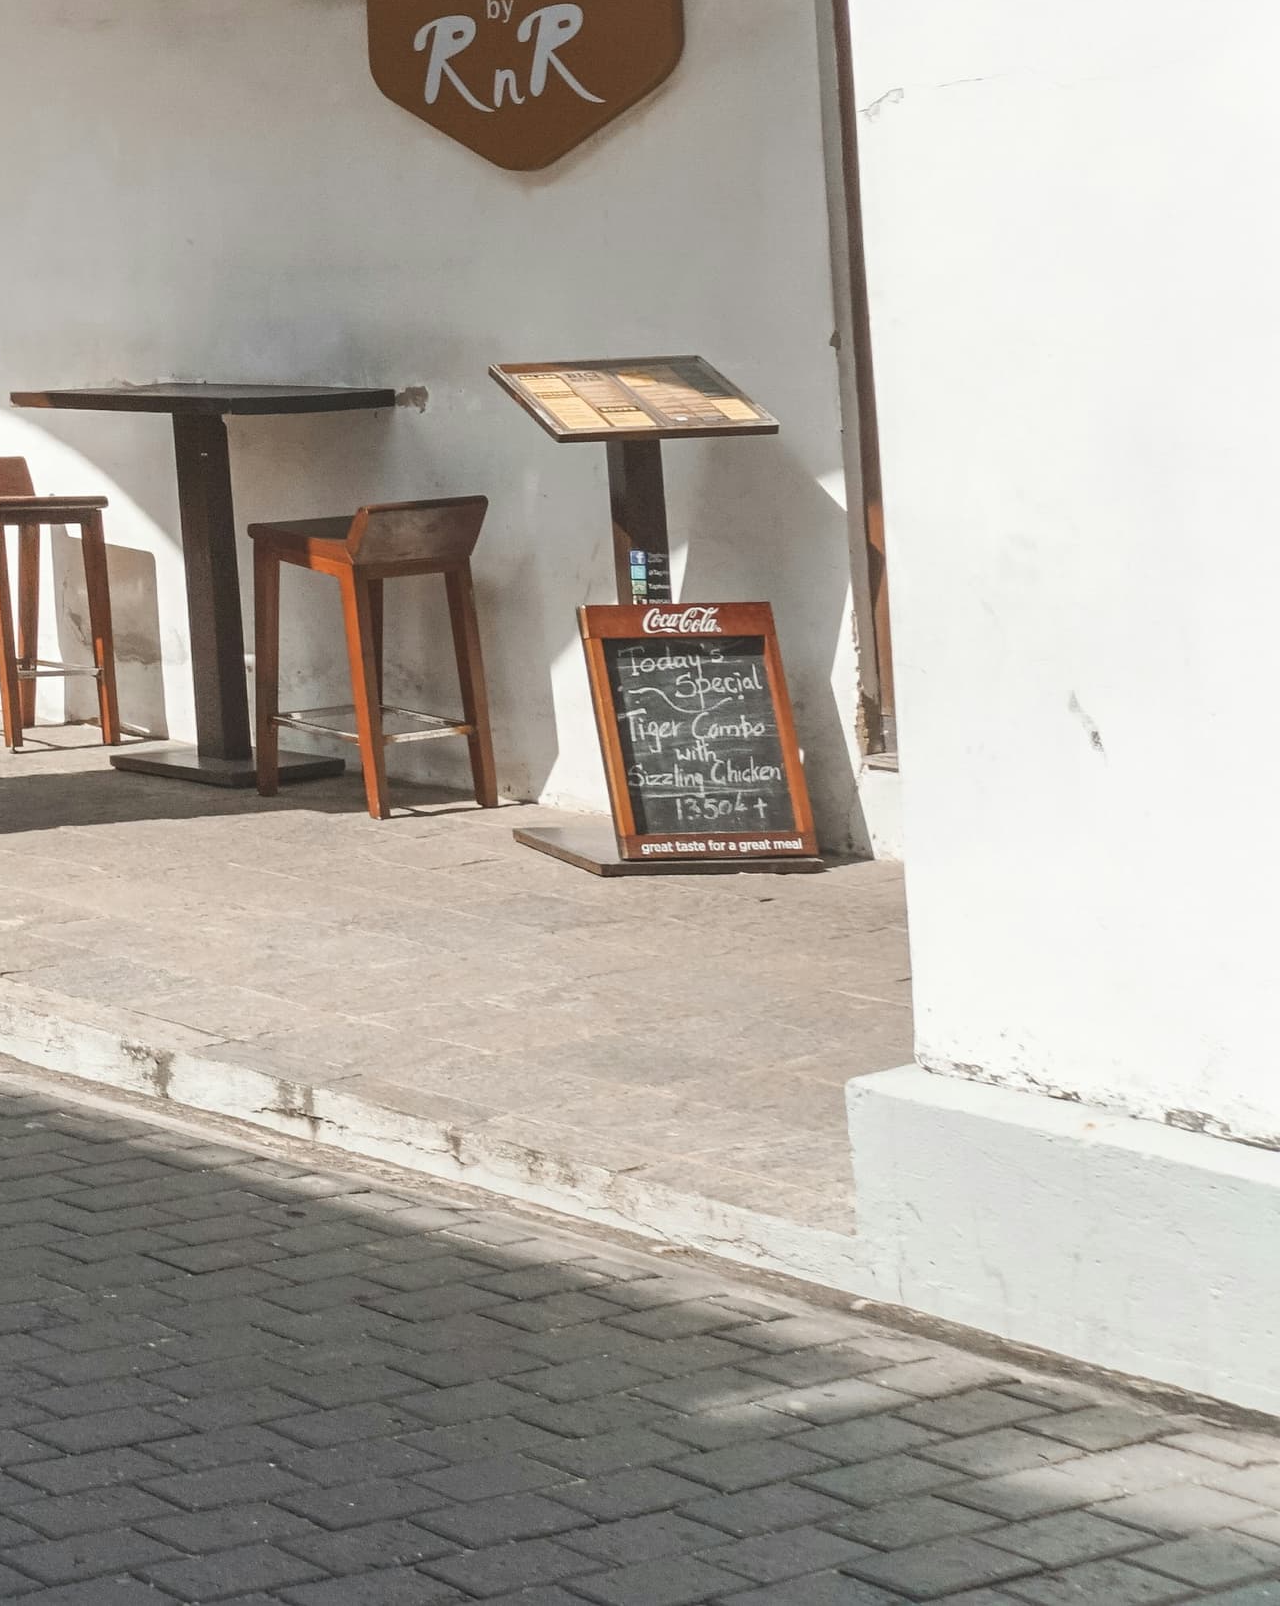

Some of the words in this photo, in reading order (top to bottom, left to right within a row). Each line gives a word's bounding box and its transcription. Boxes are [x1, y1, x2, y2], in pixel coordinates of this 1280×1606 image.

[413, 2, 606, 112] RnR
[617, 643, 724, 678] Today's
[675, 663, 763, 710] Special
[626, 708, 684, 753] Tiger
[692, 711, 765, 739] Combo
[675, 740, 718, 763] with
[628, 763, 704, 797] Sizzling
[710, 756, 783, 785] Chicken
[641, 842, 673, 855] great
[676, 841, 705, 852] taste
[708, 839, 726, 851] for
[728, 841, 737, 851] a
[739, 839, 771, 852] great
[773, 838, 803, 850] meal
